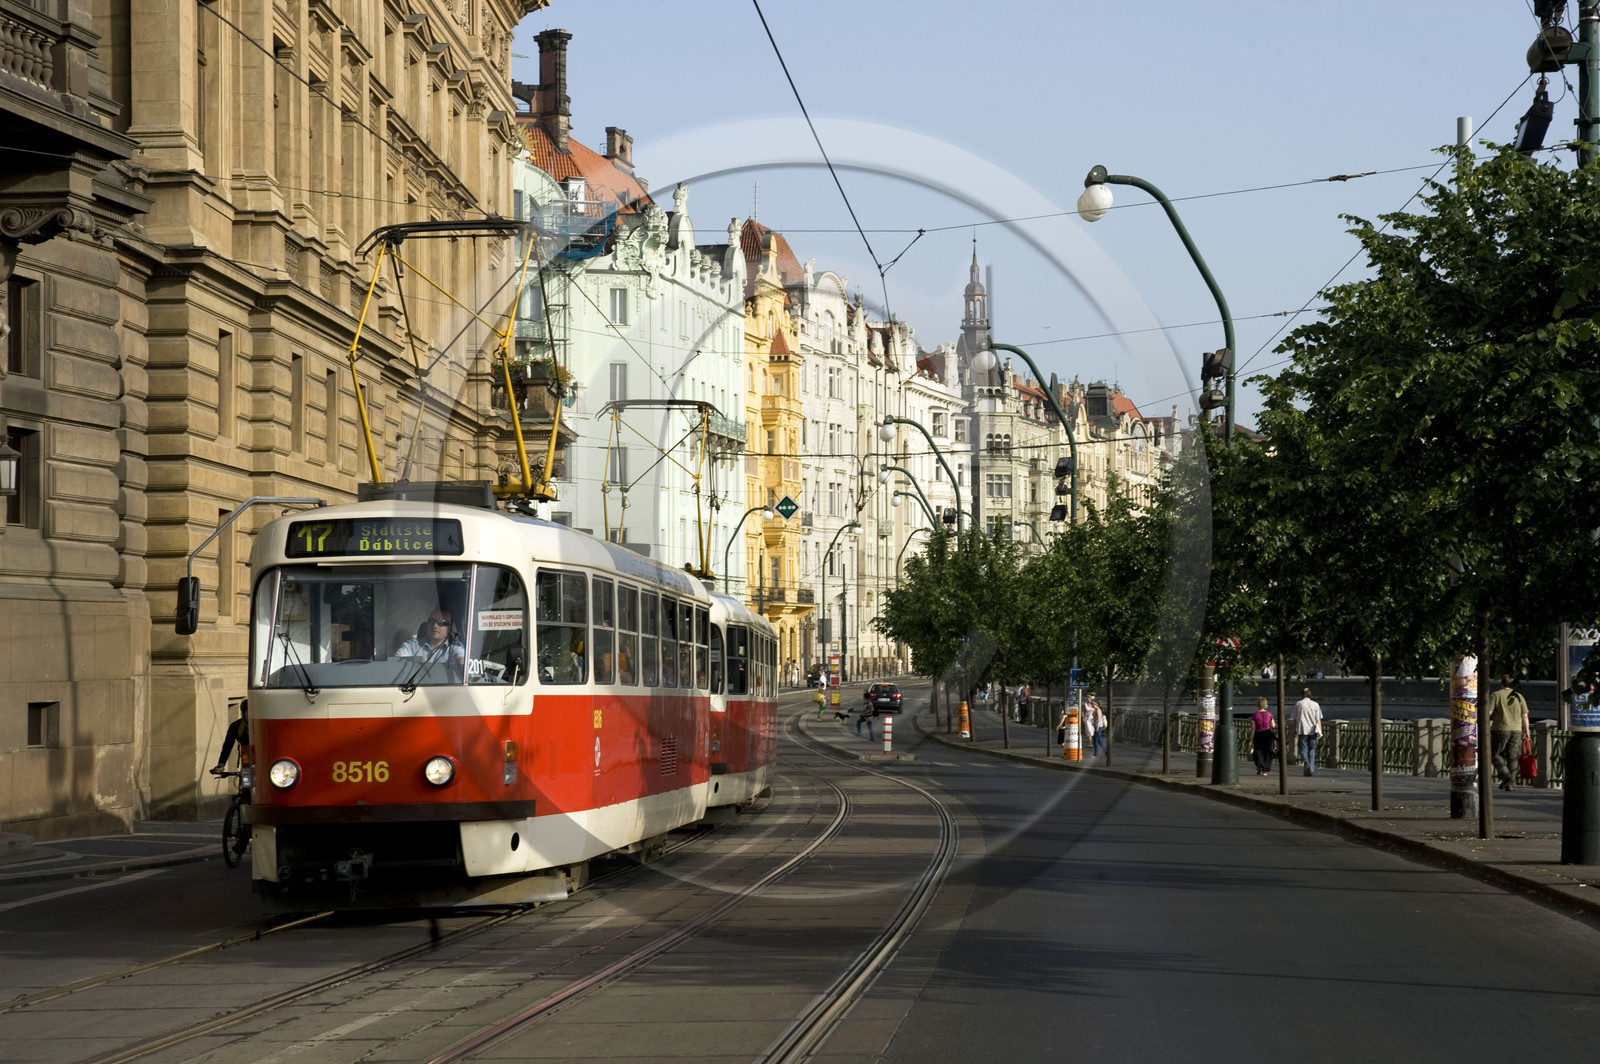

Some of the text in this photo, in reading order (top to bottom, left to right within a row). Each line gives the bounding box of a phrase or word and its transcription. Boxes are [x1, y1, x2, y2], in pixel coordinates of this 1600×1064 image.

[298, 524, 332, 552] 17
[359, 537, 433, 551] Ďáblice
[468, 659, 484, 675] 201
[332, 760, 390, 783] 8516
